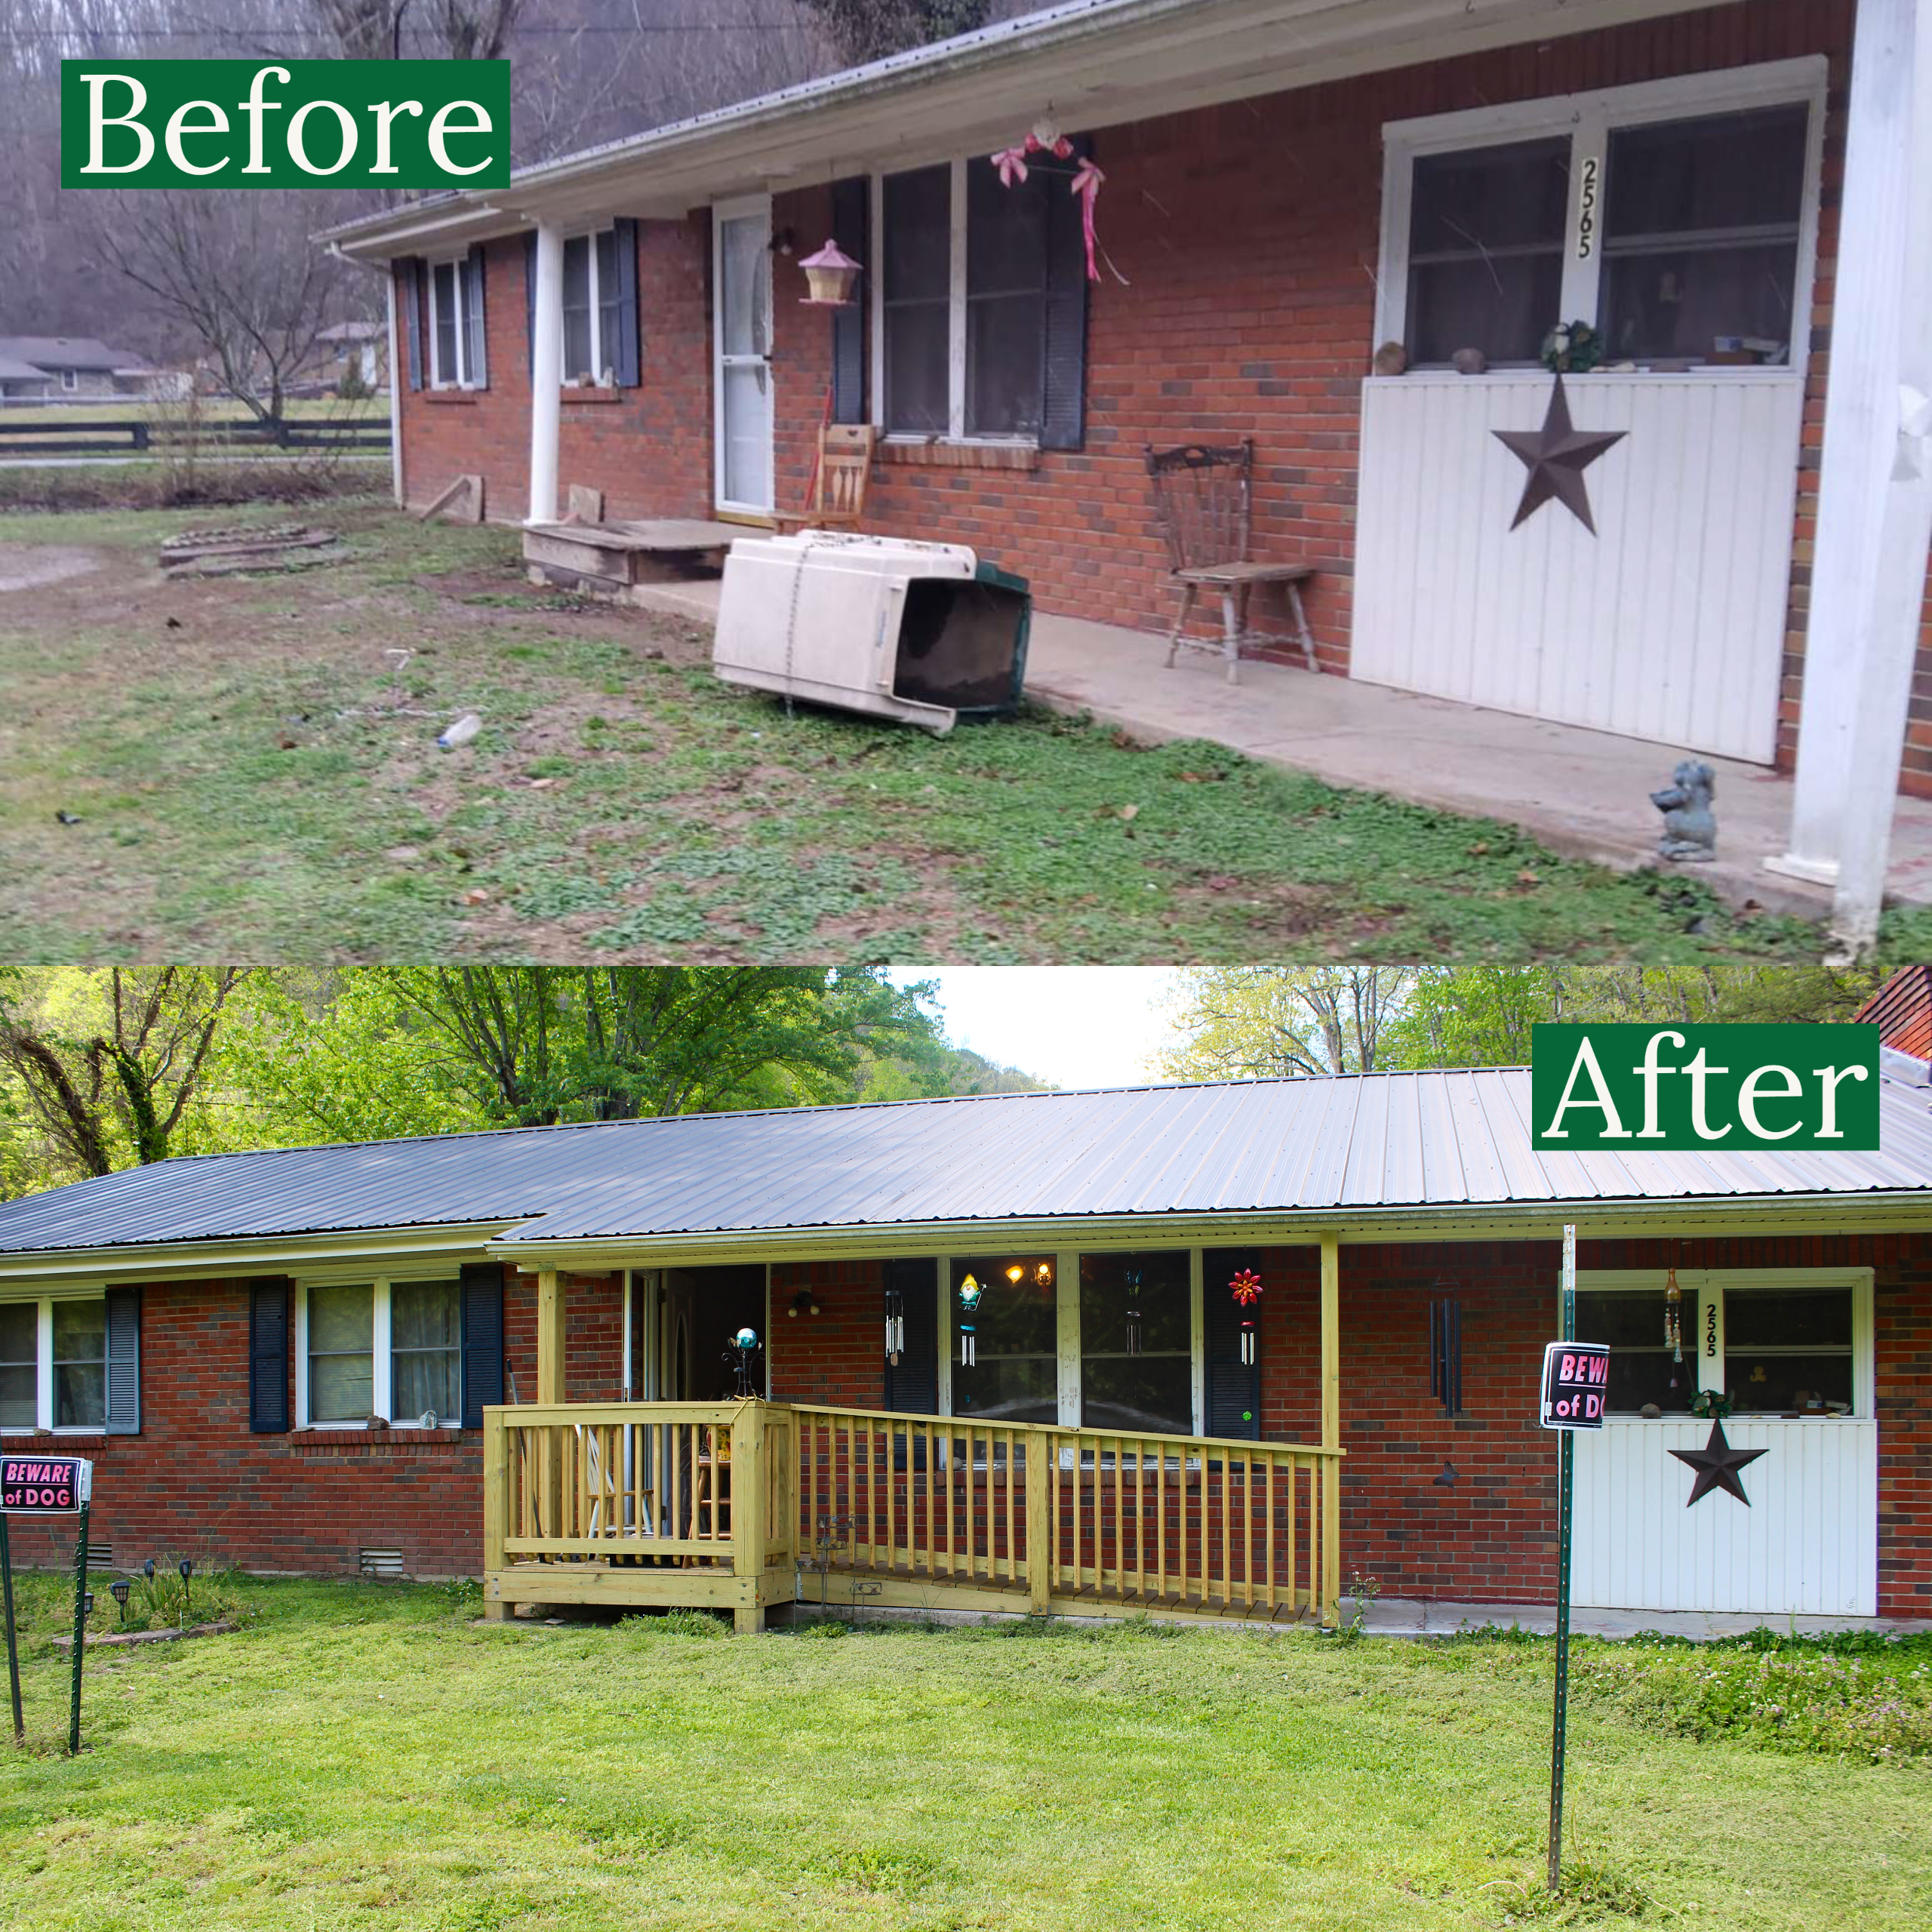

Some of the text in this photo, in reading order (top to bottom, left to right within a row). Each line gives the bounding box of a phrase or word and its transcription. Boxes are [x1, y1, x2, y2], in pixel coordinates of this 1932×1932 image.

[1578, 158, 1596, 258] 2565
[1706, 1303, 1717, 1357] 2565
[1555, 1394, 1606, 1419] of D
[6, 1463, 72, 1483] BEWARE
[5, 1488, 71, 1506] of DOG
